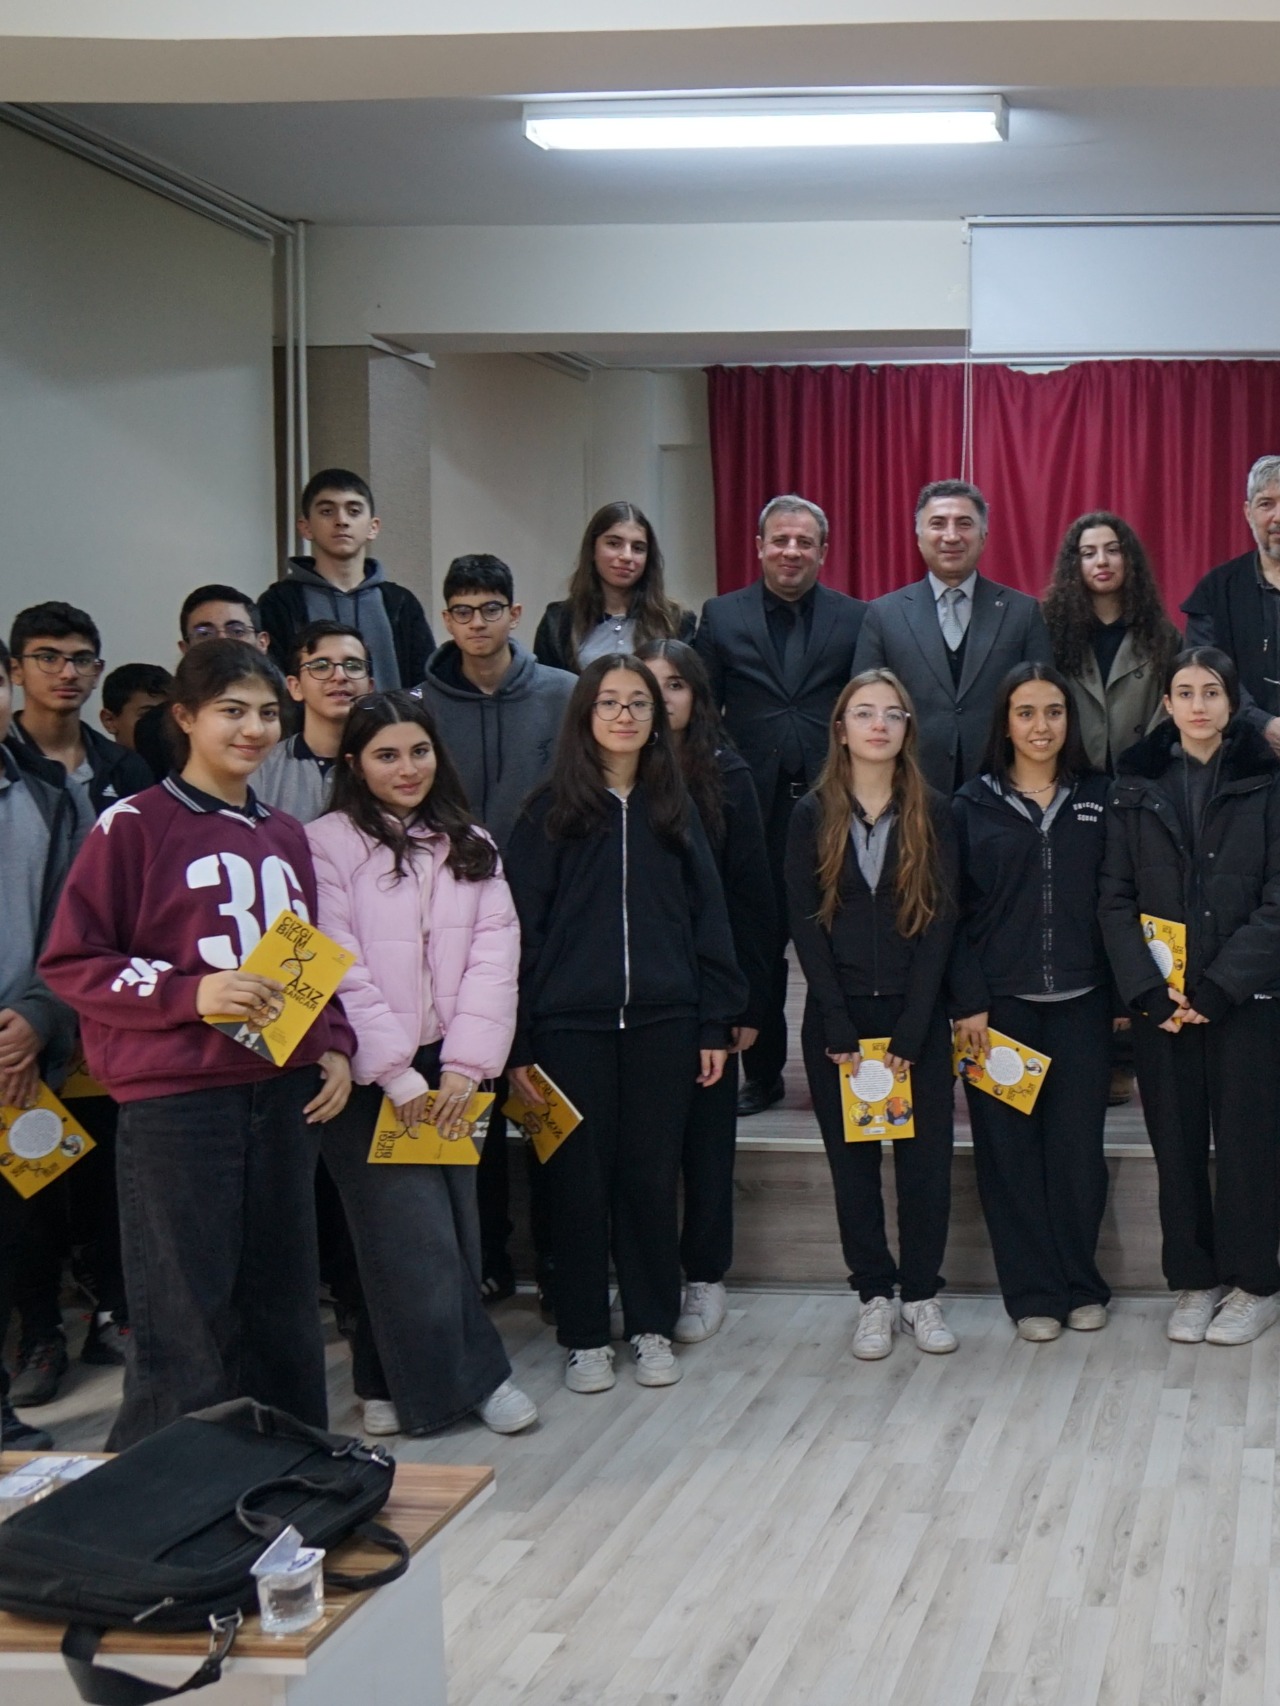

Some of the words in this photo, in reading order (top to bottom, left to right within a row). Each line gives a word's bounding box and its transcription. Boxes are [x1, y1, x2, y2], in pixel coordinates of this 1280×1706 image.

[186, 852, 311, 970] 36
[275, 923, 308, 950] BİLİM
[287, 978, 324, 1006] AZİZ
